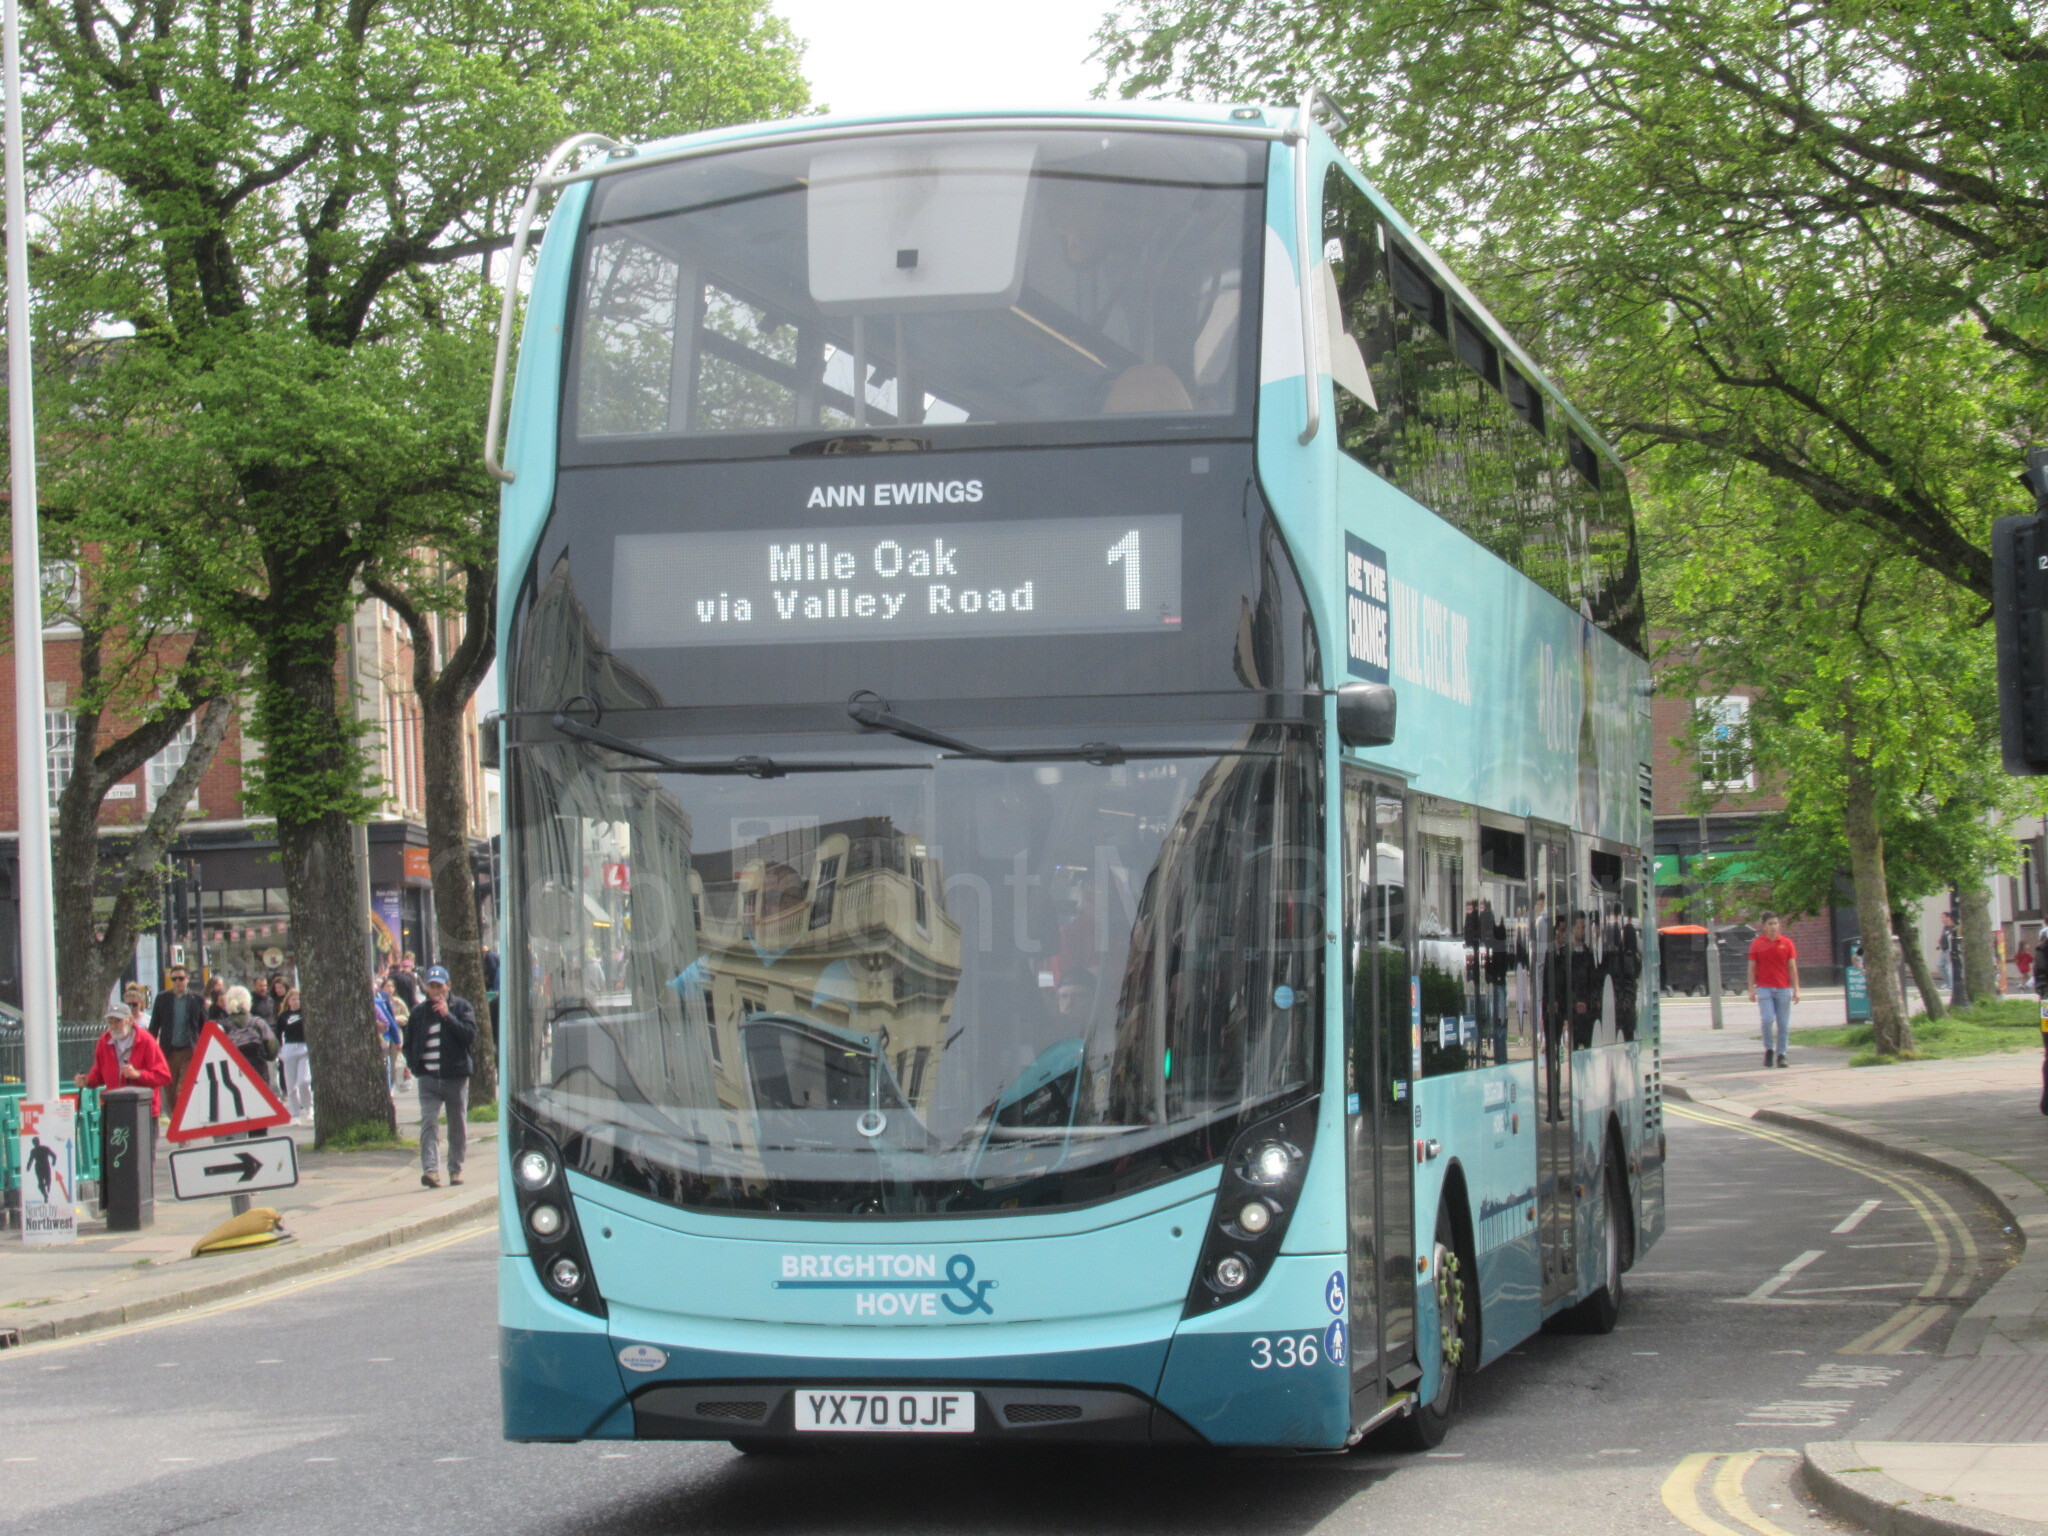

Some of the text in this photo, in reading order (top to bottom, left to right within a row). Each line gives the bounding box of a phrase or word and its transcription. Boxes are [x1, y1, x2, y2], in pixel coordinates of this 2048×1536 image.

[807, 479, 984, 508] ANN EWINGS
[769, 538, 958, 582] Mile Oak
[1107, 530, 1141, 611] 1
[1347, 551, 1387, 603] BE THE
[696, 581, 1034, 622] via Valley Road
[1348, 593, 1388, 670] CHANGE
[25, 1204, 58, 1219] North by
[25, 1217, 73, 1231] Northwest
[780, 1254, 936, 1280] BRIGHTON
[855, 1292, 937, 1317] HOVE
[1250, 1334, 1318, 1369] 336
[809, 1395, 960, 1426] YX70 OJF
